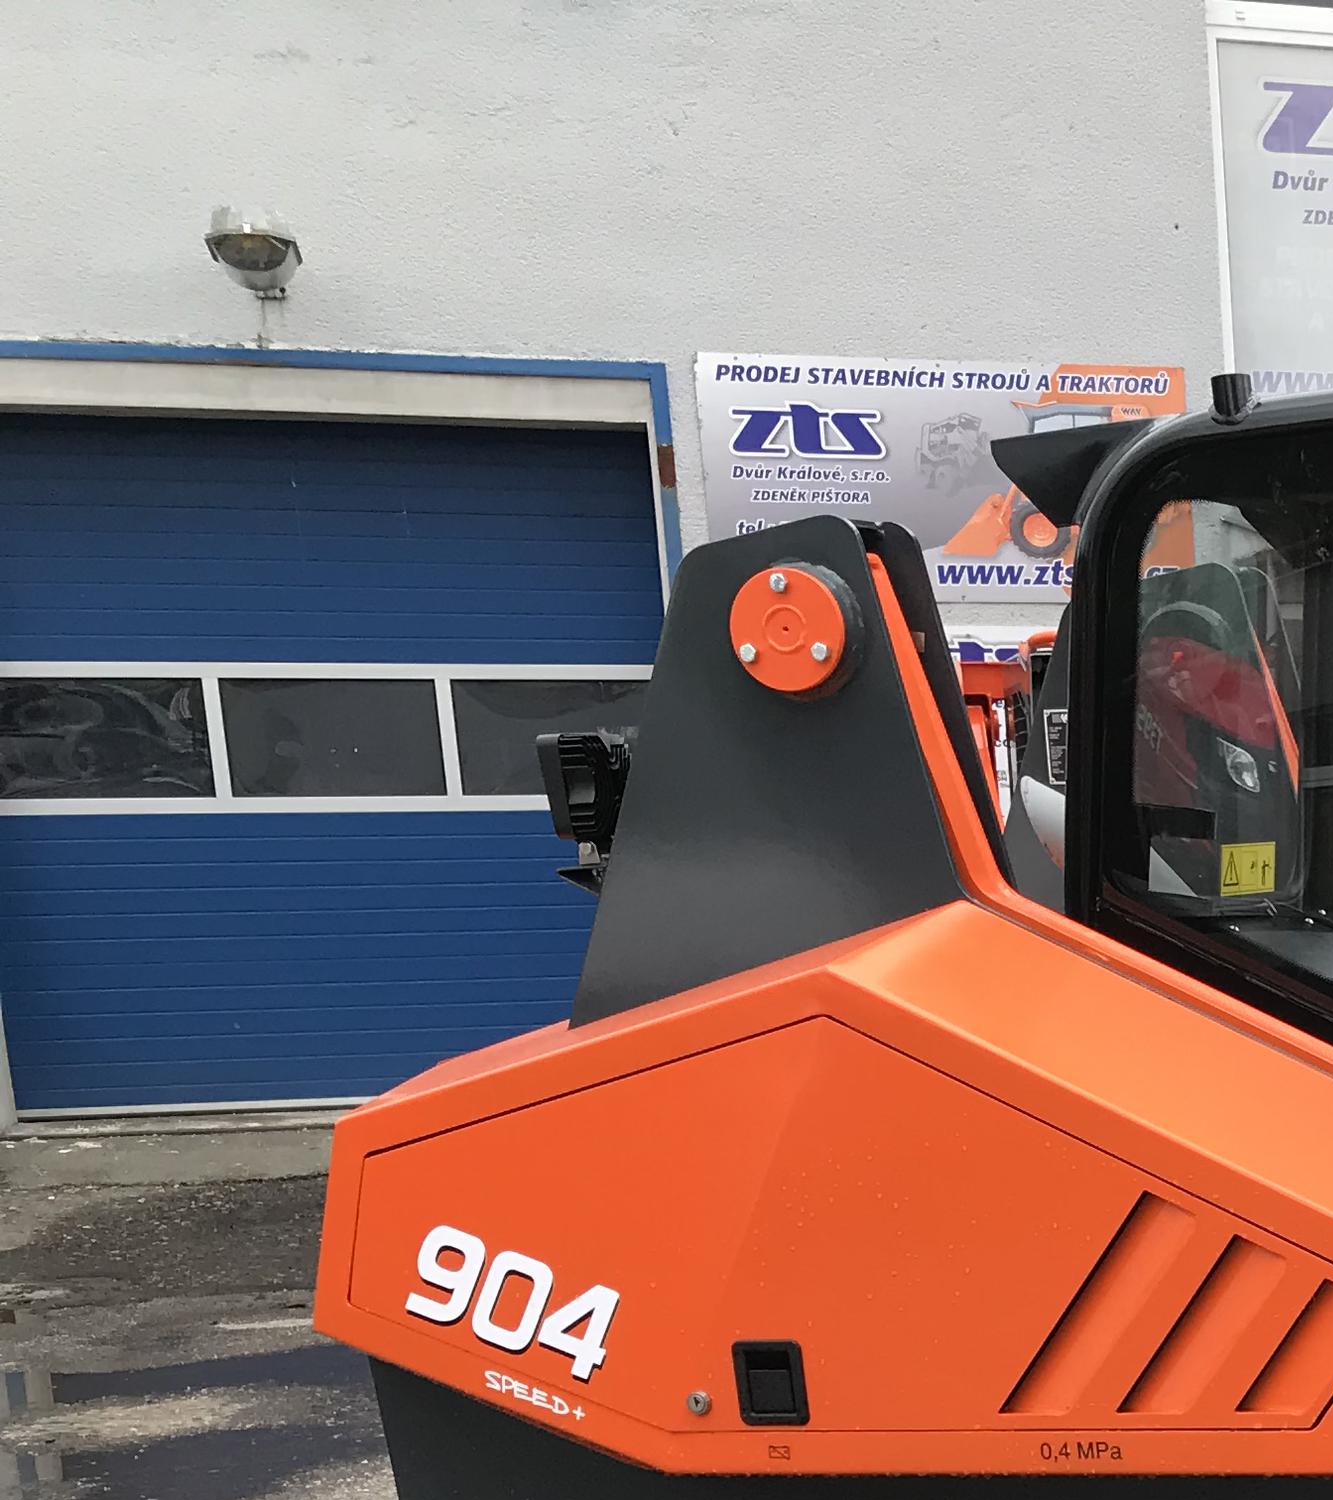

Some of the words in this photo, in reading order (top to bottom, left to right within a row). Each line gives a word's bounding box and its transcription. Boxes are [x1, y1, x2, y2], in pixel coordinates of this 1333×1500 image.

[1271, 169, 1329, 191] Dvůr
[715, 364, 801, 384] PRODEJ
[807, 366, 945, 388] STAVEBNÍCH
[951, 369, 1030, 391] STROJŮ
[1035, 374, 1050, 391] A
[1058, 373, 1169, 395] TRAKTORŮ
[730, 402, 884, 457] zts
[732, 463, 772, 479] Dvůr
[777, 466, 846, 483] Králové,
[850, 470, 890, 482] s.r.o.
[752, 488, 807, 502] ZDENĚK
[811, 489, 871, 503] PIŠTORA
[405, 1224, 621, 1385] 904
[1040, 1441, 1071, 1463] 0,4
[1076, 1441, 1124, 1460] MPa
